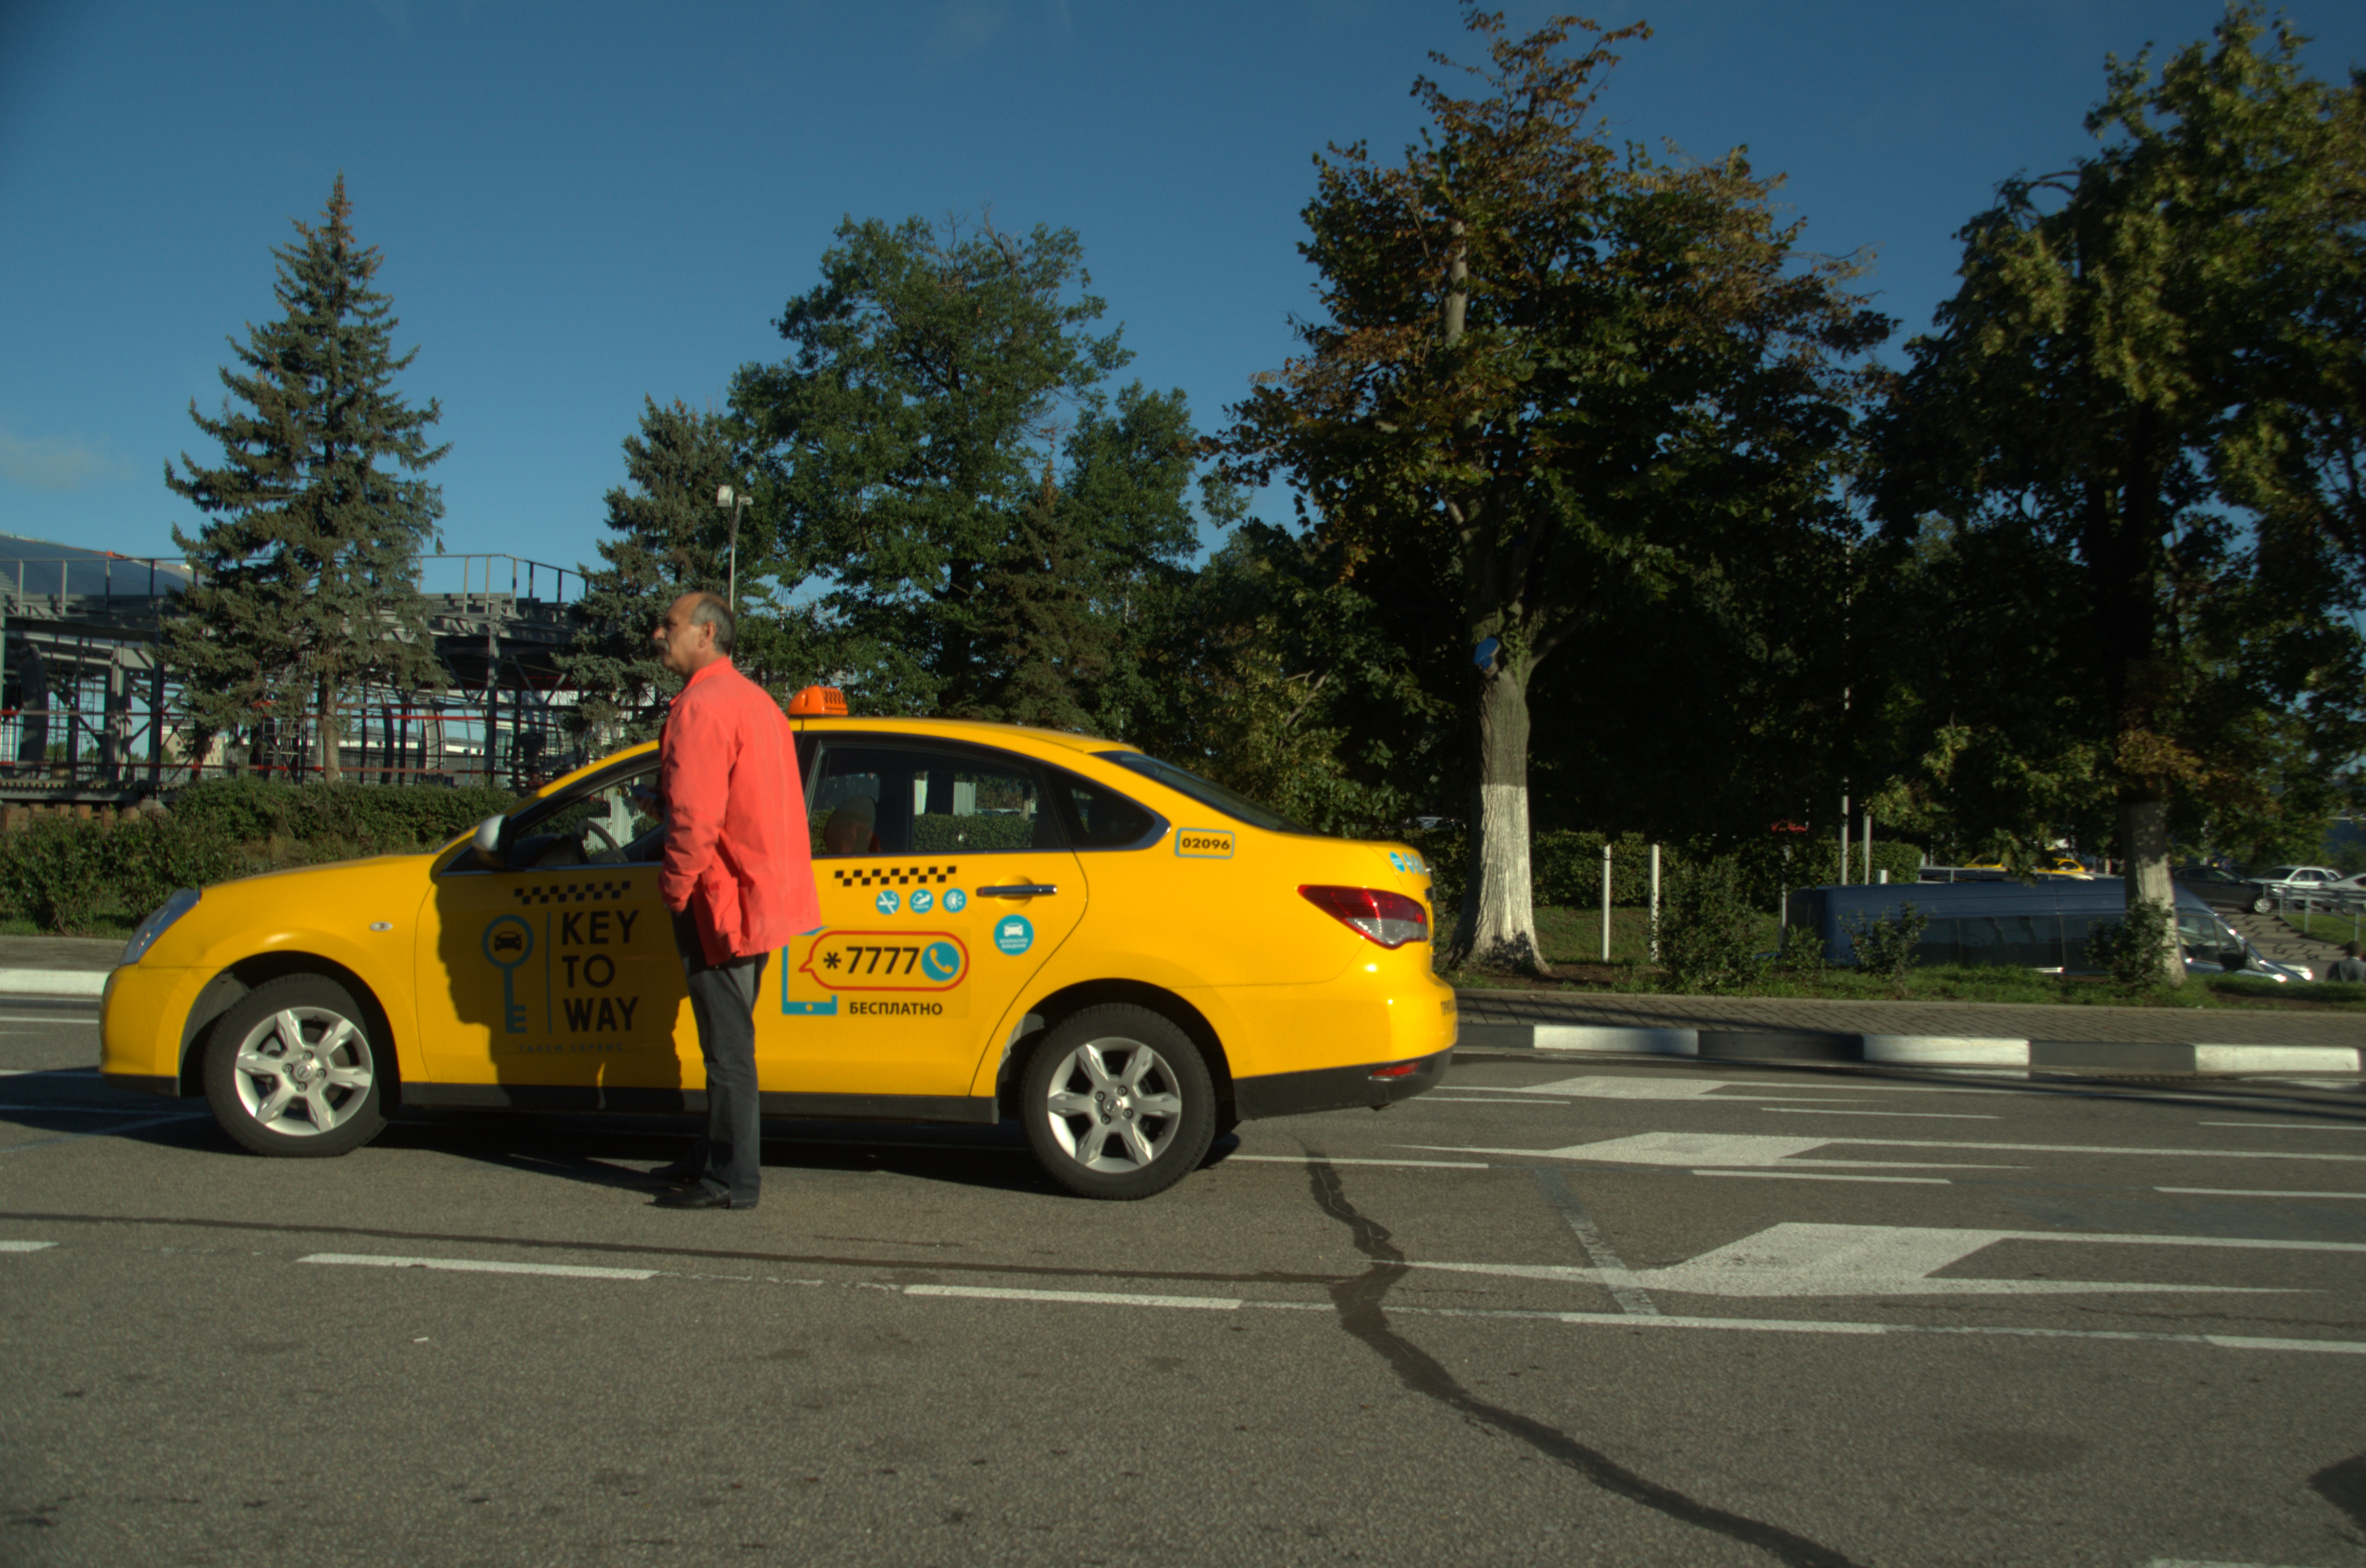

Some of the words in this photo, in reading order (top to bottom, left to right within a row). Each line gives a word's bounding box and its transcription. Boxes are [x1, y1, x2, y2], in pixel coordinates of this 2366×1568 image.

[1182, 838, 1230, 850] 02096
[561, 910, 639, 945] KEY
[561, 954, 615, 988] TO
[563, 997, 639, 1032] WAY
[849, 1002, 942, 1015] БЕСПЛАТНО
[518, 1044, 562, 1053] ТАКСИ
[570, 1043, 624, 1052] СЕРВИС
